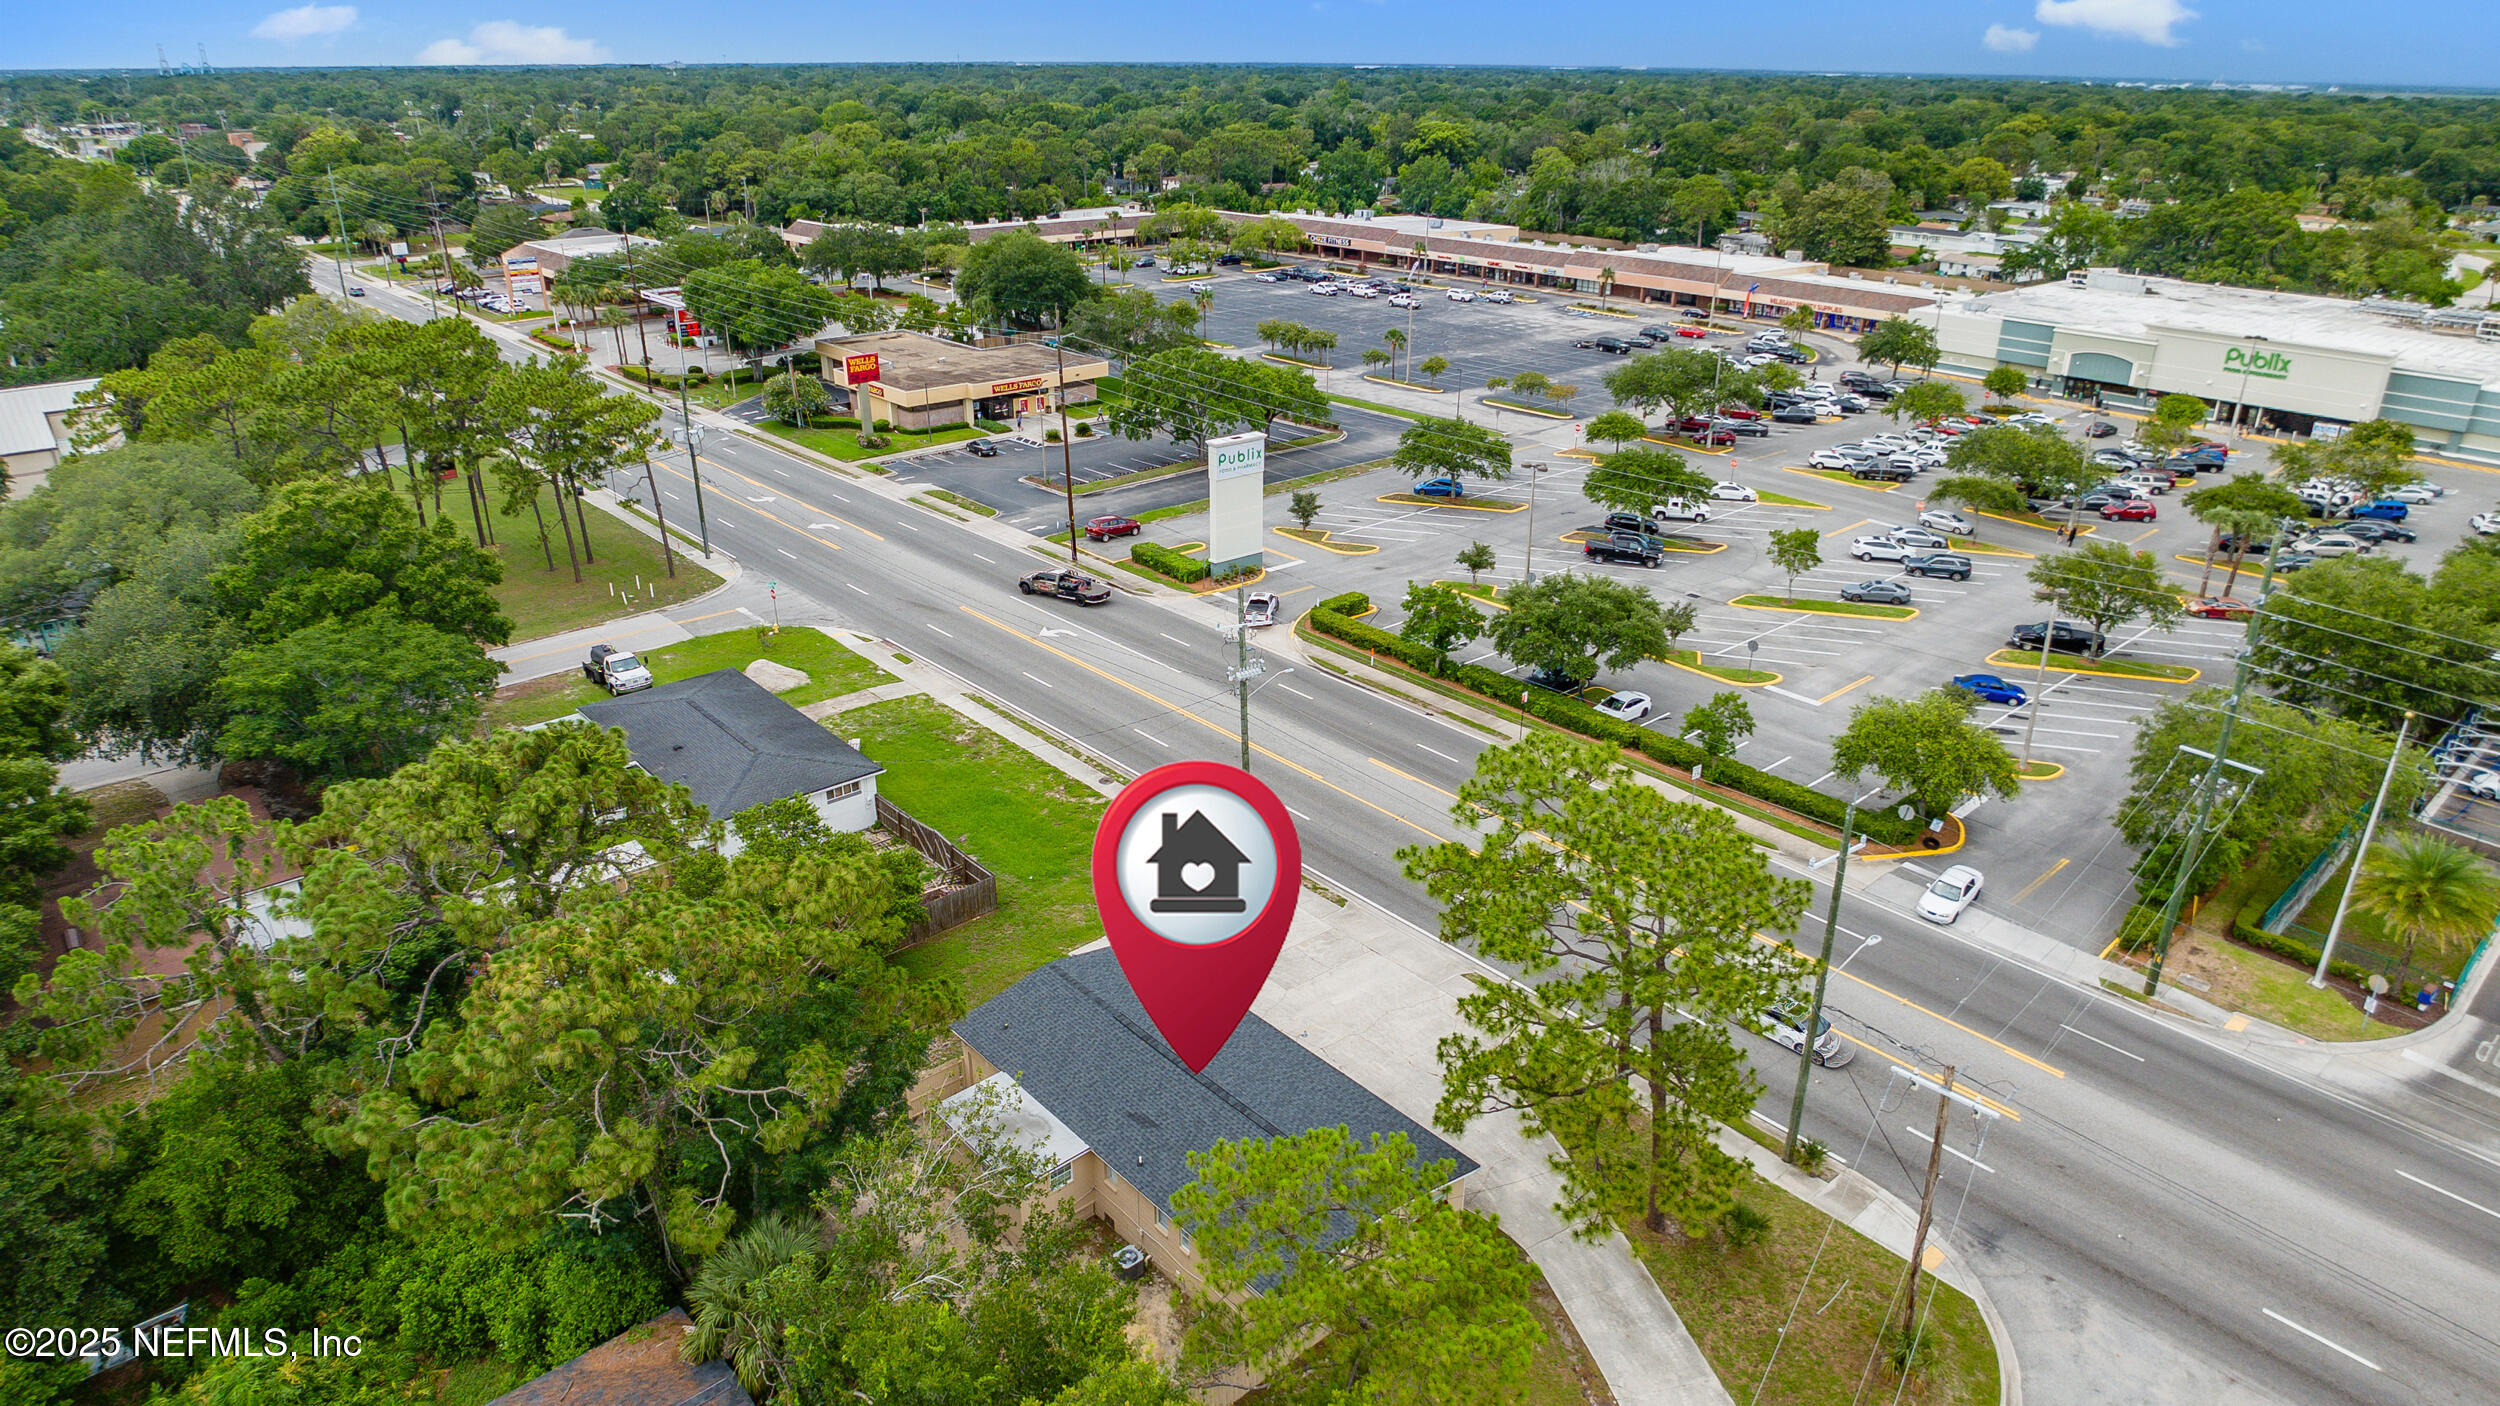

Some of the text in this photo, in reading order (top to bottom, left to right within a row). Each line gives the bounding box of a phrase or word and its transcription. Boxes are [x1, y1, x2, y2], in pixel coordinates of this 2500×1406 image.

[848, 356, 875, 366] WELLS
[2224, 347, 2291, 373] Publix
[850, 363, 876, 373] FARGO
[994, 383, 1018, 393] WELLS
[1218, 447, 1262, 466] Publix
